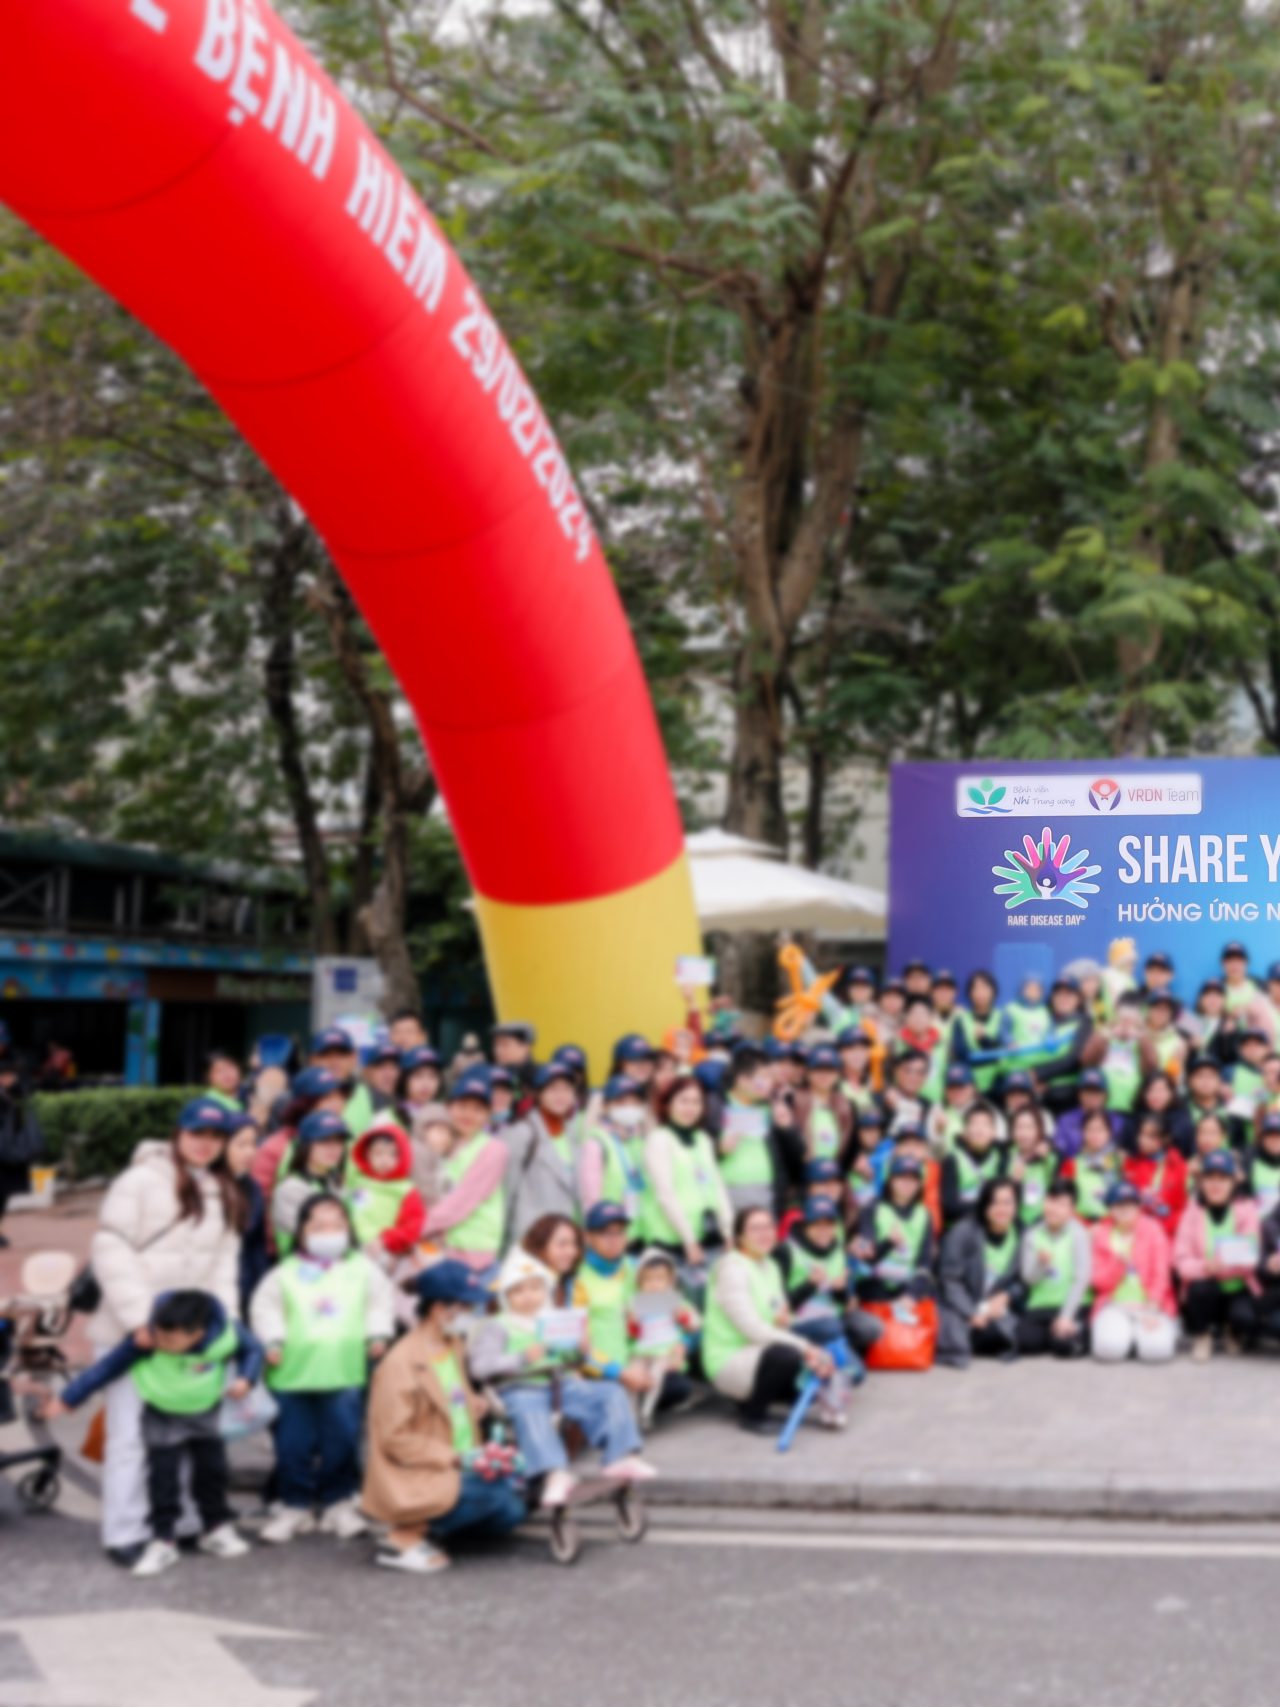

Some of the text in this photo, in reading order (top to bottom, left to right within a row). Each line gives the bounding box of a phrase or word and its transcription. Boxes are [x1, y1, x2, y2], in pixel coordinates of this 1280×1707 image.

[1128, 788, 1200, 802] VRDN Team
[1118, 834, 1249, 884] SHARE
[1117, 896, 1203, 922] HƯỞNG
[1209, 898, 1260, 922] ỨNG
[1007, 915, 1029, 926] RARE
[1030, 915, 1064, 926] DISEASE
